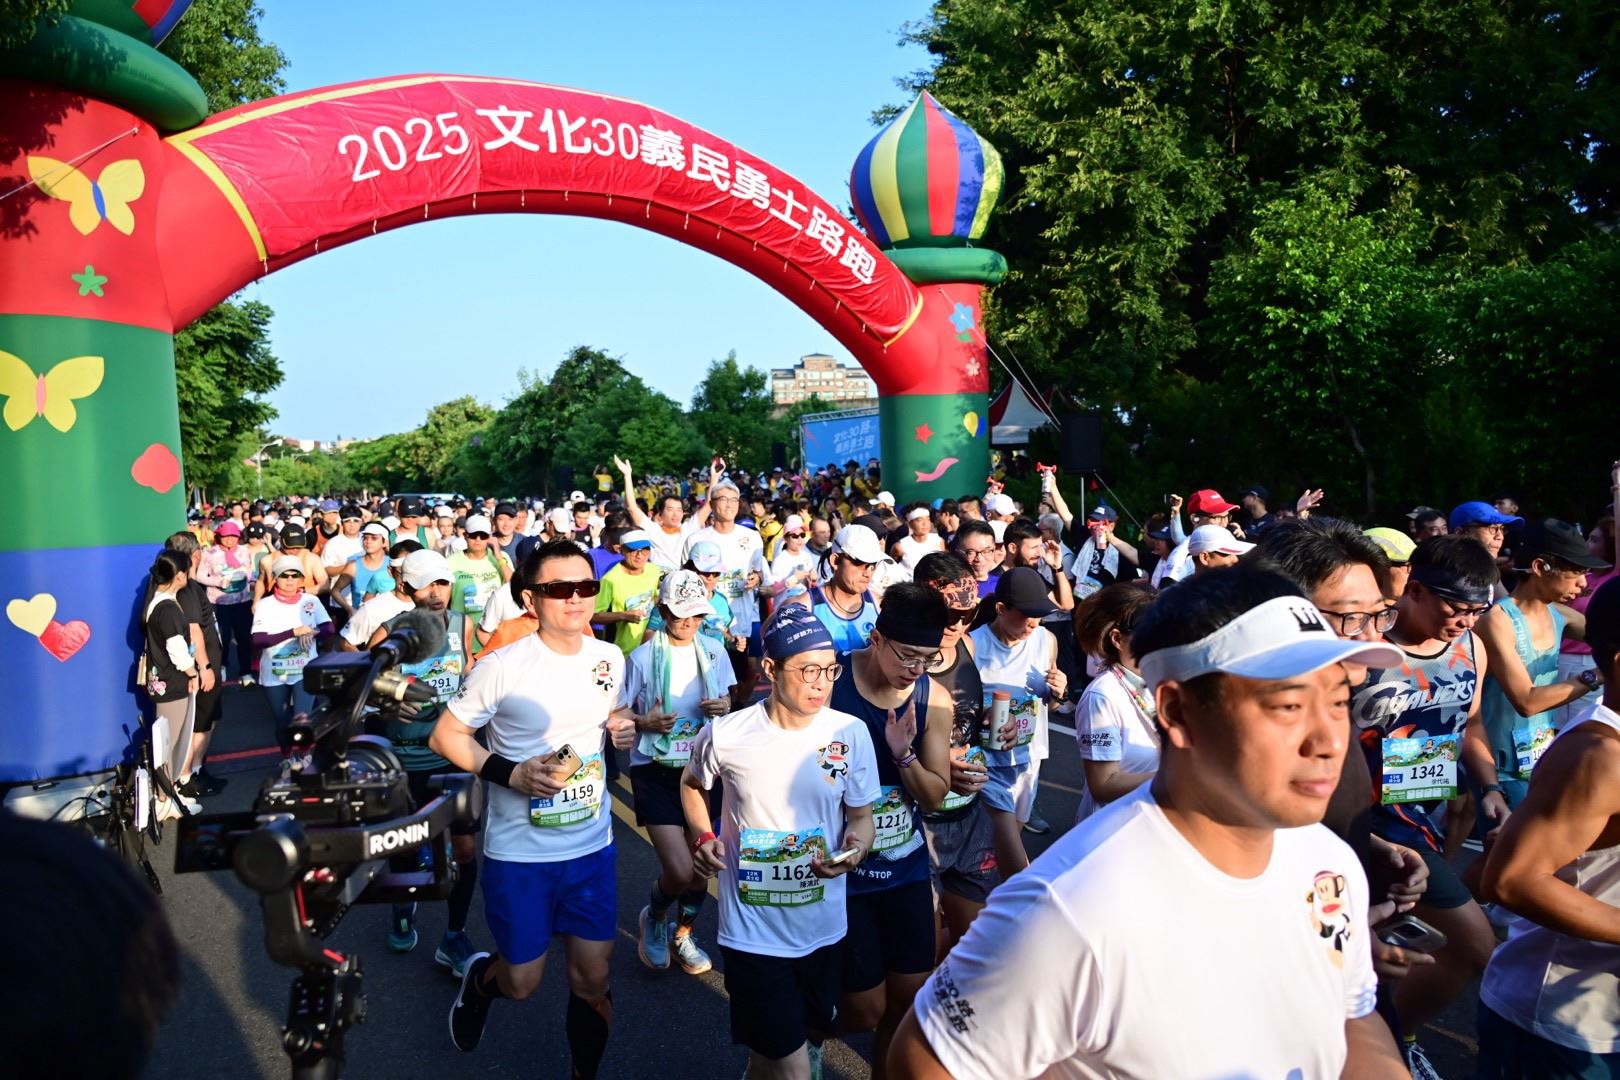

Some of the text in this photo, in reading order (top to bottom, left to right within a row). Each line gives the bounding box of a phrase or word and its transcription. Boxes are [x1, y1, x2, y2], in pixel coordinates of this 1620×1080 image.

[1410, 763, 1444, 780] 1342
[561, 784, 594, 803] 1159
[875, 810, 907, 830] 1217
[370, 820, 429, 855] RONIN
[771, 863, 815, 881] 1162
[868, 870, 892, 879] STOP
